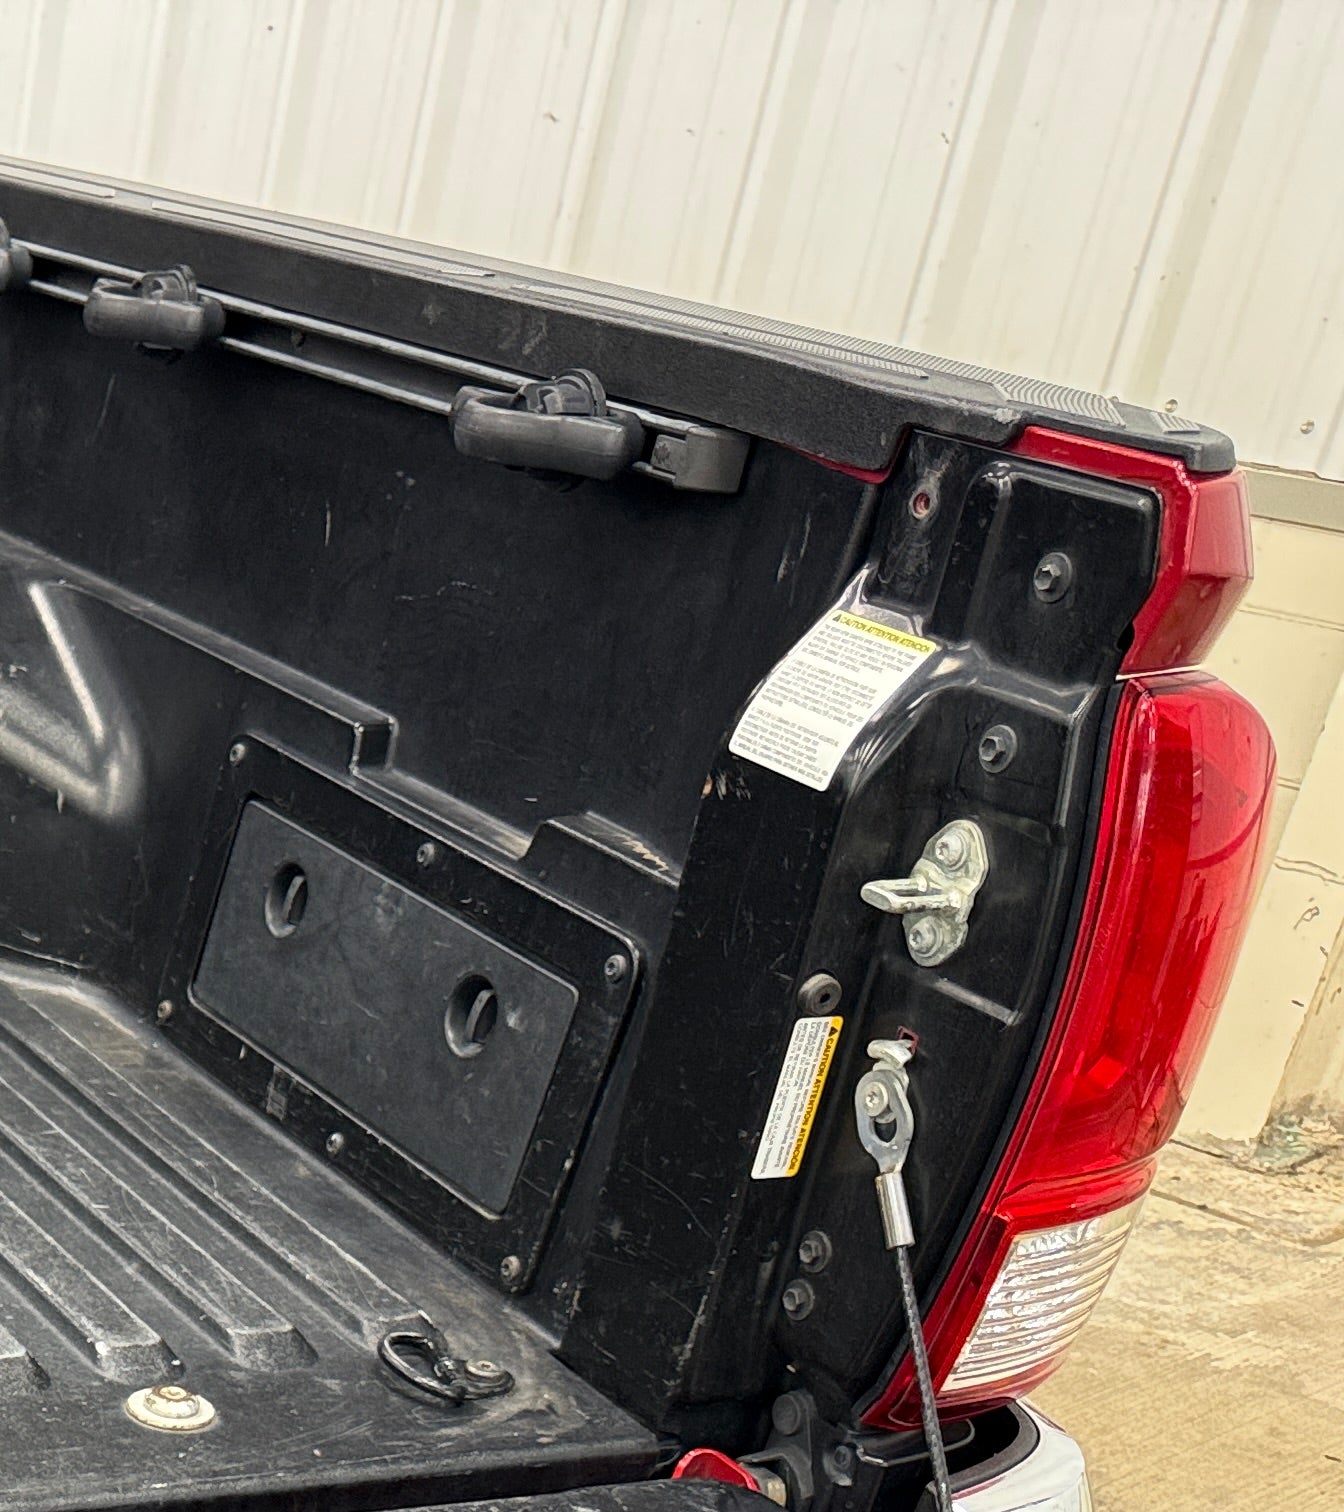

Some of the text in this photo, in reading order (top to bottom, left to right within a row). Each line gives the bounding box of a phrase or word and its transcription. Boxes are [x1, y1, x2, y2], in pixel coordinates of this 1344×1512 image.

[839, 616, 867, 631] CAUTION
[865, 626, 901, 643] ATTENTION
[816, 1037, 834, 1077] CAUTION
[802, 1078, 822, 1126] ATTENTION
